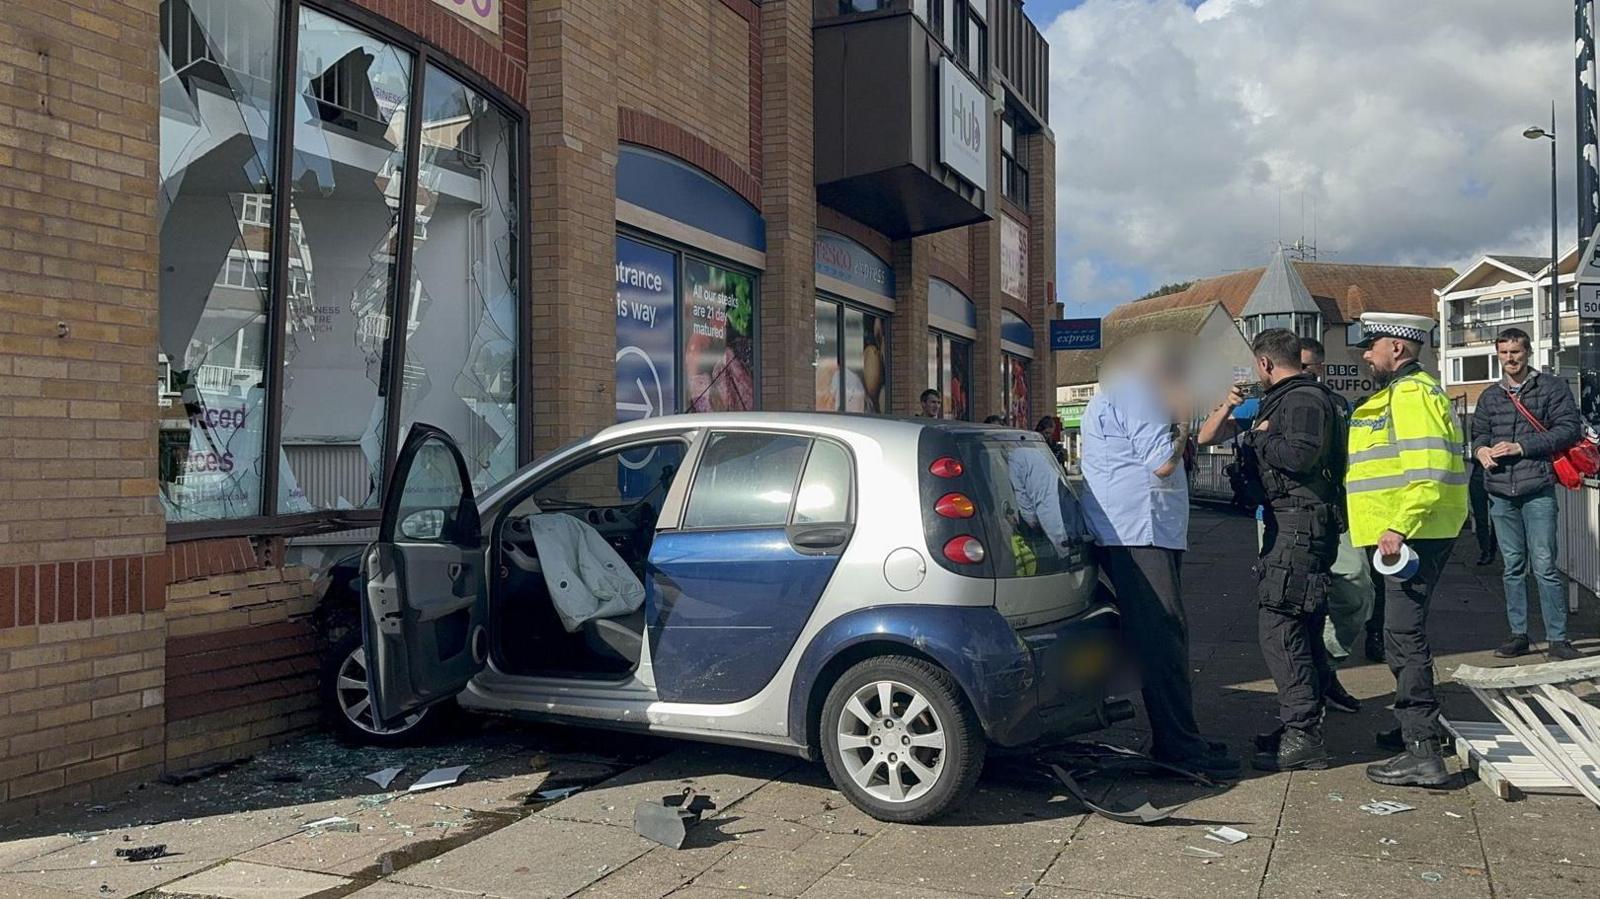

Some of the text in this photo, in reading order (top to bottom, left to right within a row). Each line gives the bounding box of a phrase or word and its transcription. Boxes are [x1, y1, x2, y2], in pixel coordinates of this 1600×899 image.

[951, 84, 981, 153] Hub
[692, 283, 739, 309] All our steaks
[631, 301, 657, 329] way
[692, 304, 728, 326] are 21 day
[693, 322, 724, 340] matured
[1057, 333, 1096, 346] express
[1327, 365, 1359, 376] BBC
[1327, 379, 1380, 391] SUFFOL
